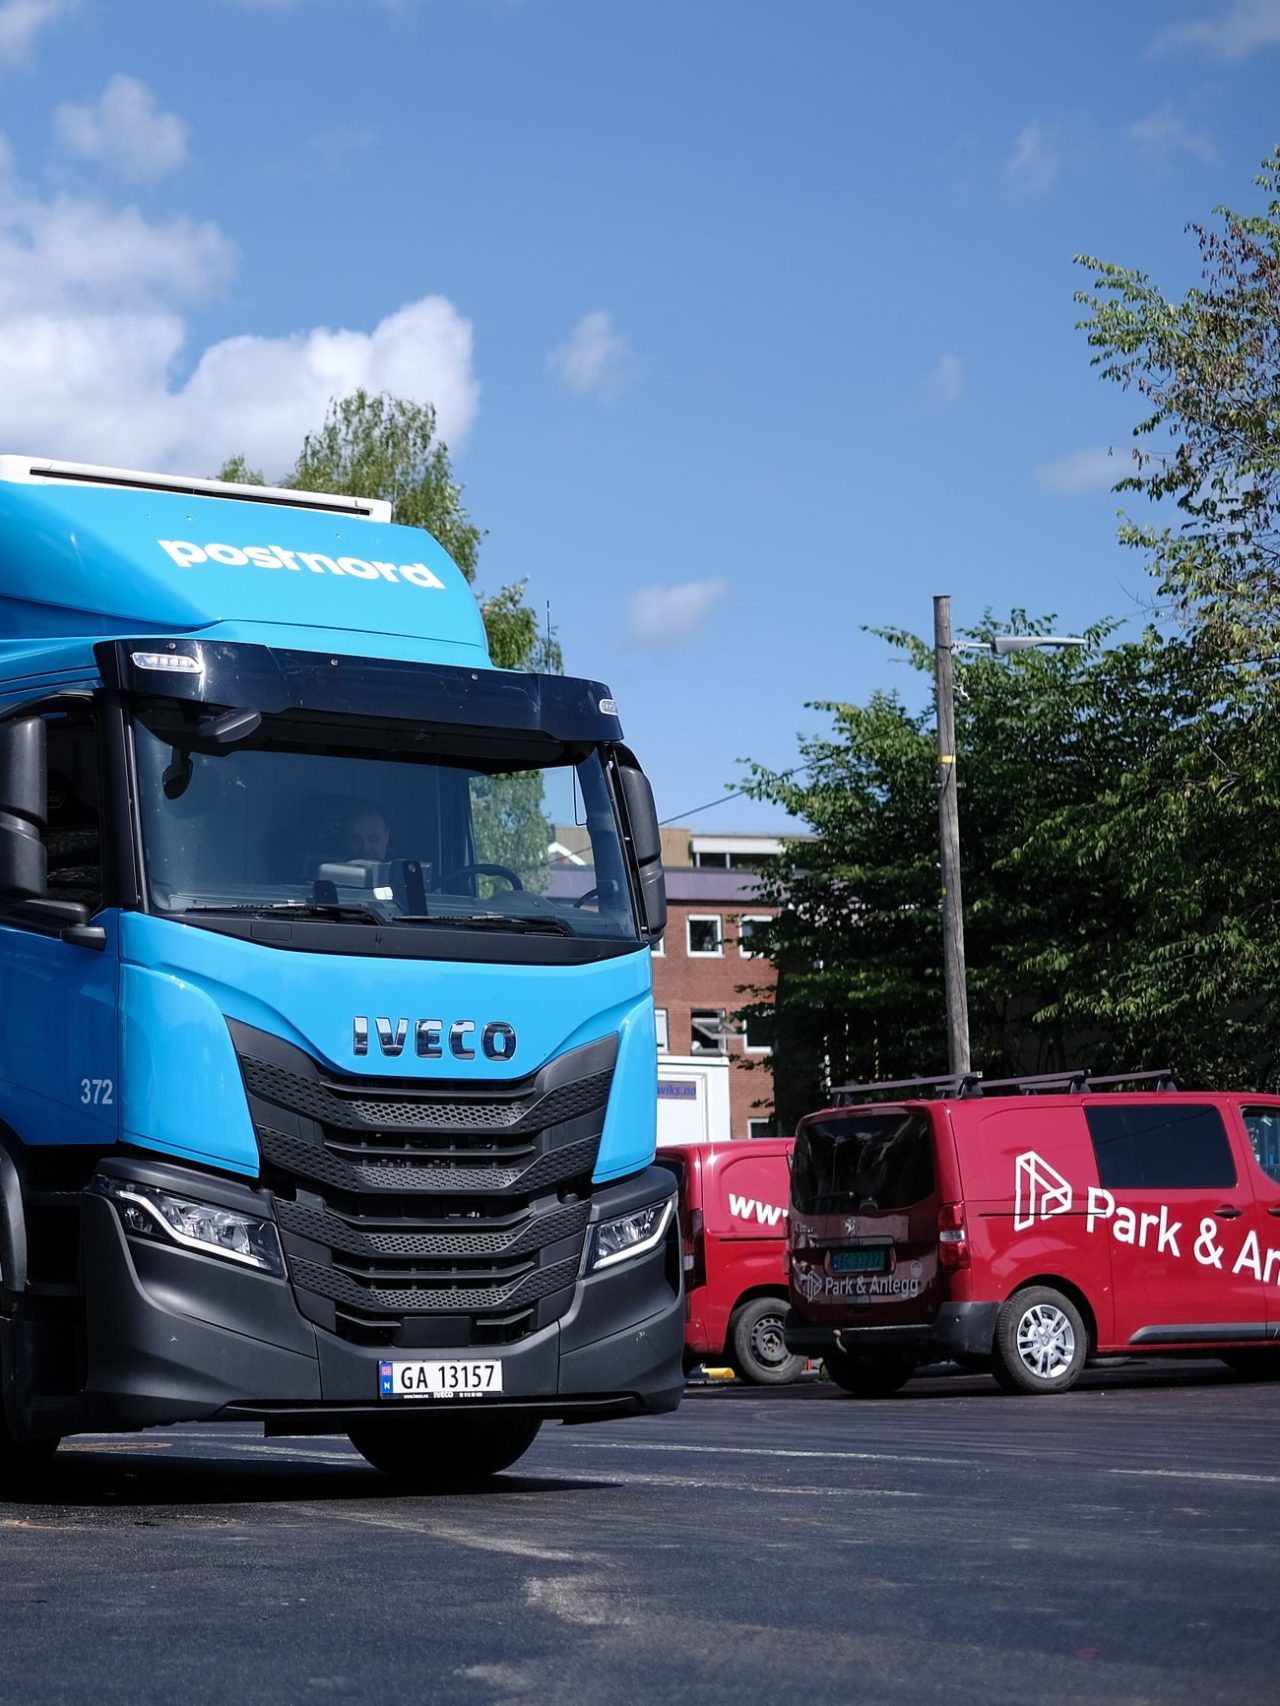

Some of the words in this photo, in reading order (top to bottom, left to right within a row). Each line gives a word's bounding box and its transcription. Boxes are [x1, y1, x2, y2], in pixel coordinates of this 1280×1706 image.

[157, 539, 447, 590] postnord
[353, 1016, 517, 1062] IVECO
[80, 1078, 113, 1105] 372
[1086, 1186, 1183, 1258] Park
[1193, 1217, 1225, 1270] &
[825, 1276, 853, 1296] Park
[856, 1275, 868, 1295] &
[869, 1274, 919, 1299] Anlegg
[400, 1366, 429, 1390] GA
[438, 1364, 495, 1389] 13157
